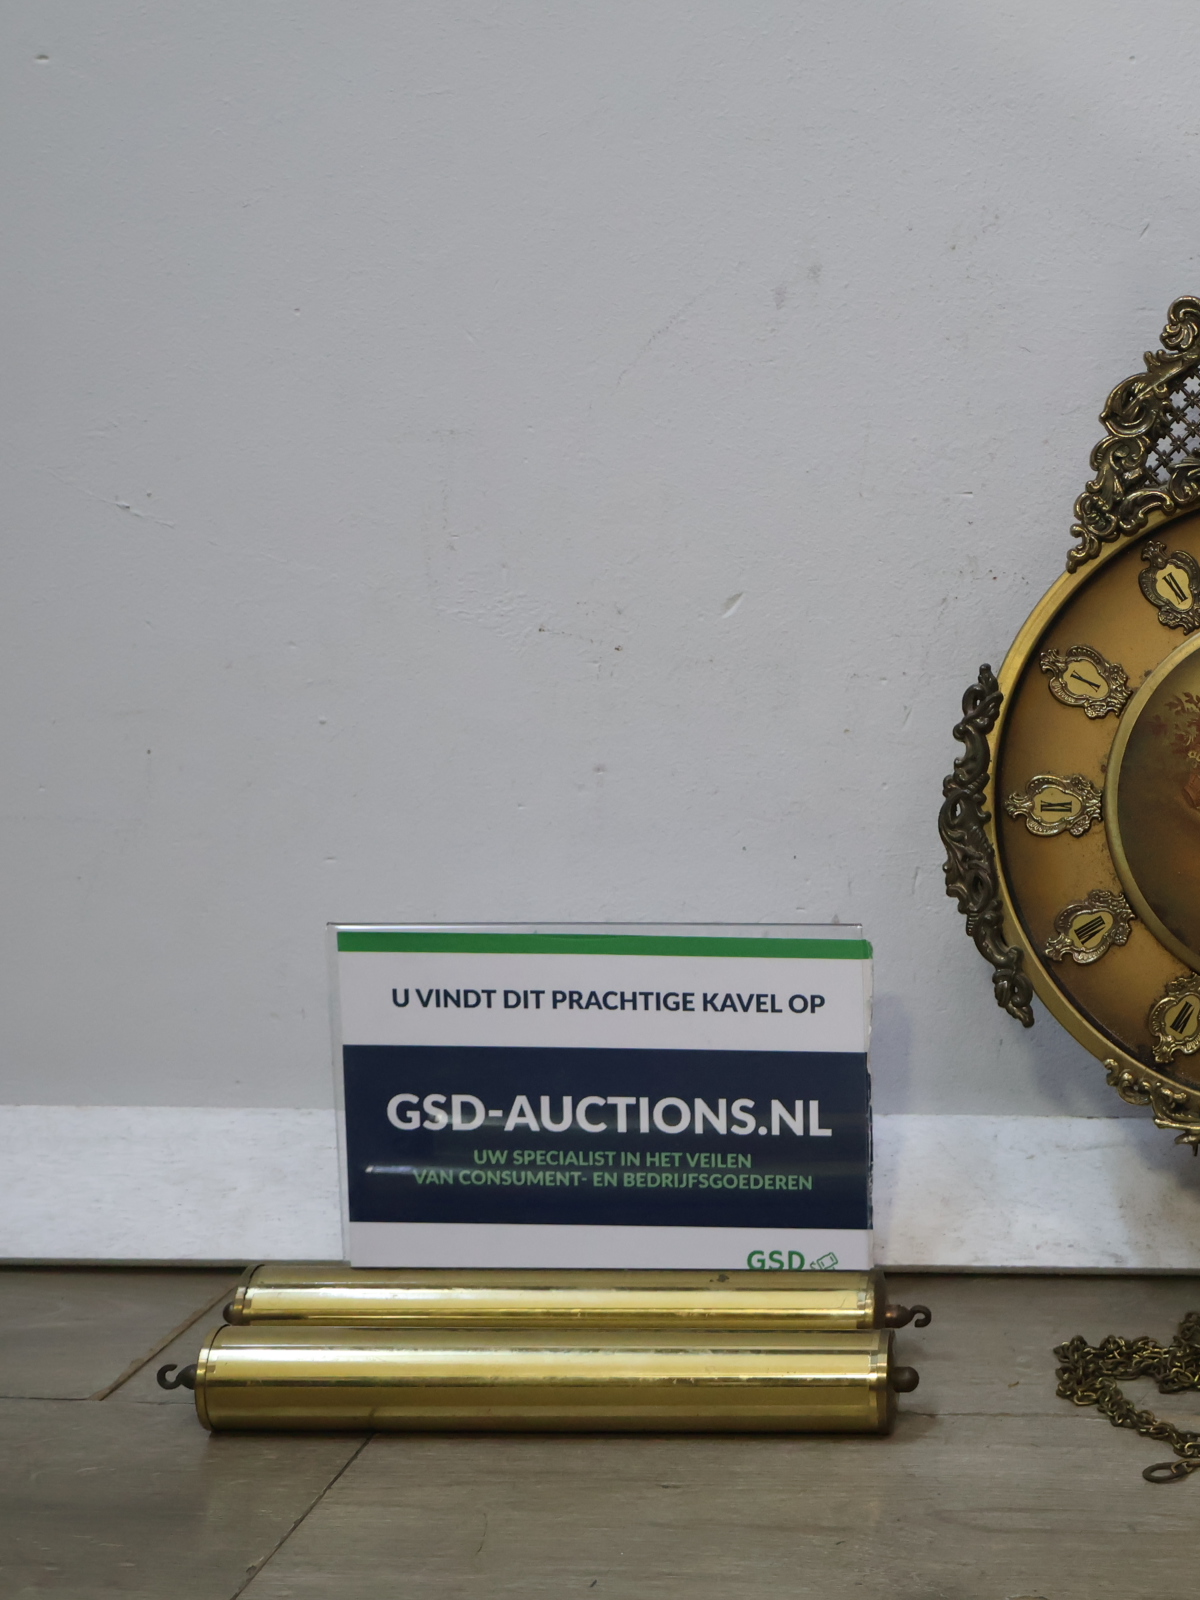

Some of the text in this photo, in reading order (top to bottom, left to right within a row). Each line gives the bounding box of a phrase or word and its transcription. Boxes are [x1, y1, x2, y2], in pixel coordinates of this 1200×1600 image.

[1162, 571, 1188, 605] XI
[1070, 669, 1101, 693] X
[1040, 800, 1073, 813] IX
[1073, 915, 1106, 945] VIII
[391, 987, 826, 1014] U VINDT DIT PRACHTIGE KAVEL OP
[1169, 1000, 1195, 1035] VII
[386, 1092, 833, 1137] GSD-AUCTIONS.NL
[473, 1149, 752, 1169] UW SPECIALIST IN HET VEILEN
[413, 1169, 813, 1190] VAN CONSUMENT- EN BEDRIJFSGOEDEREN
[747, 1250, 806, 1271] GSD
